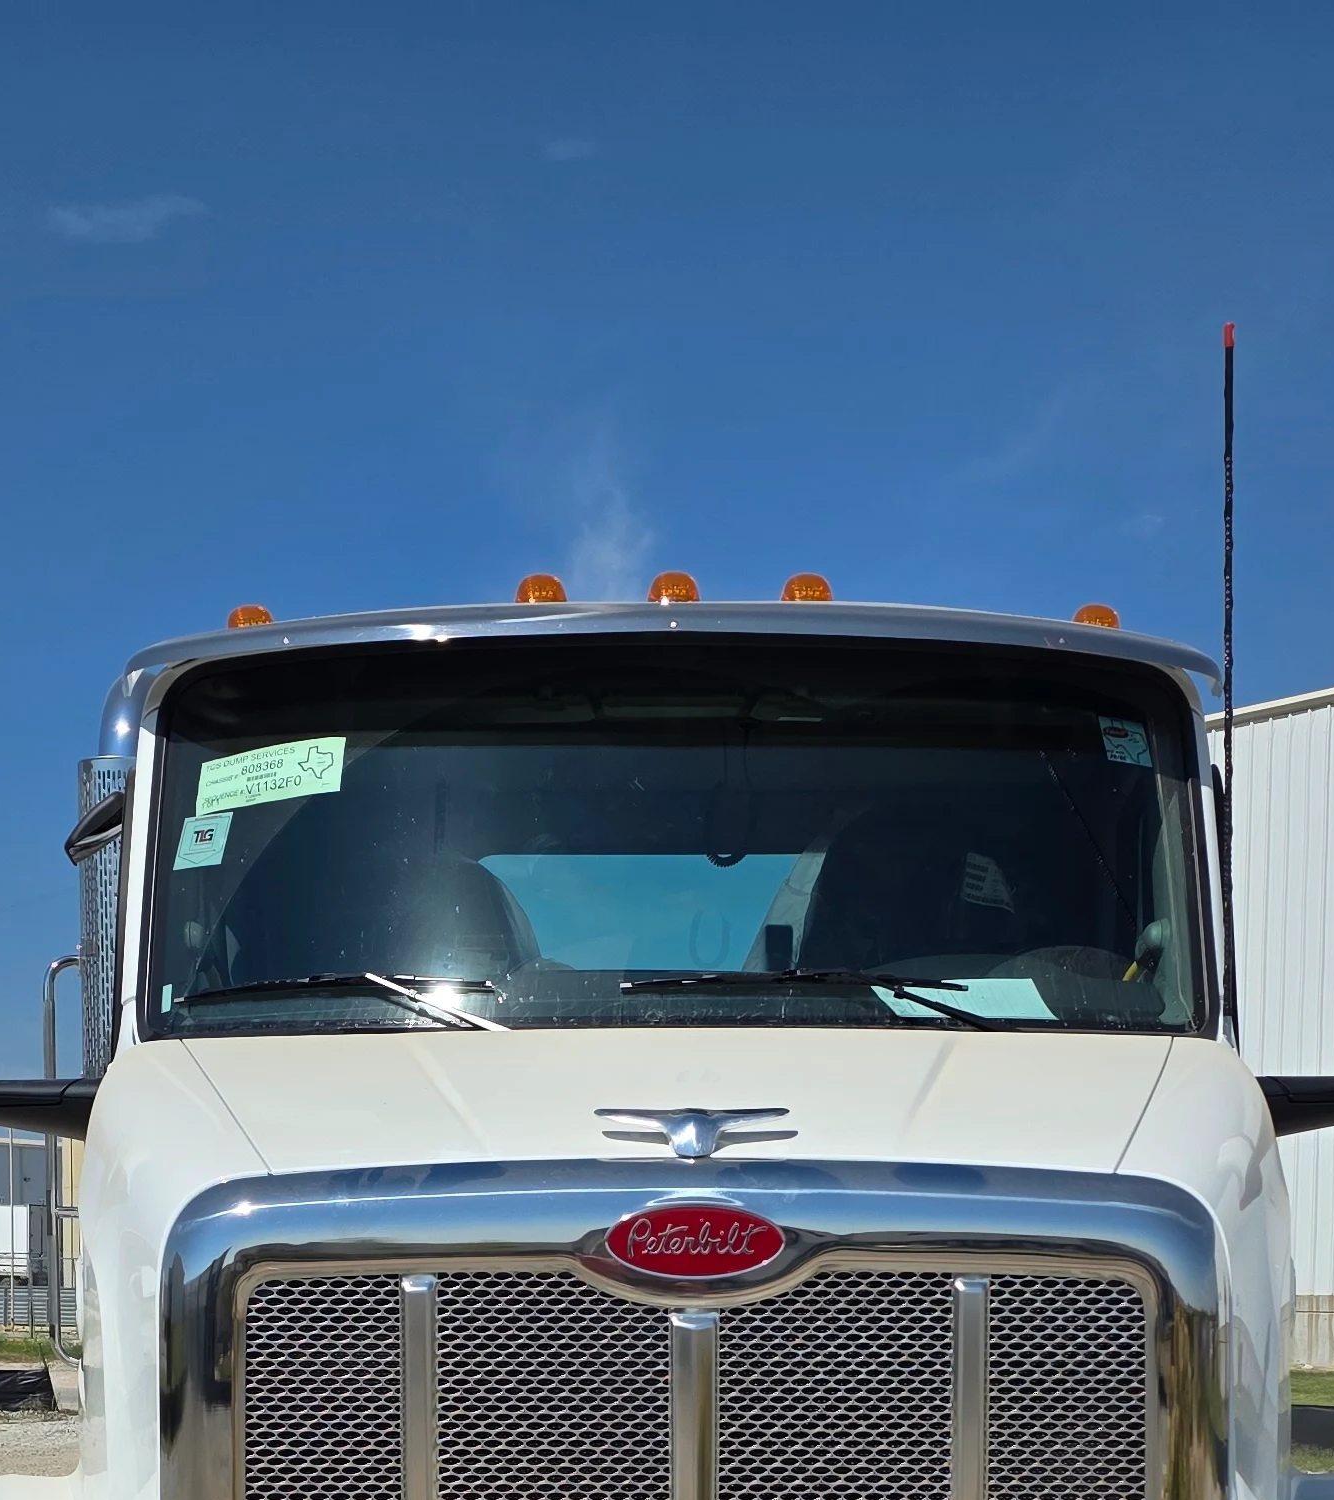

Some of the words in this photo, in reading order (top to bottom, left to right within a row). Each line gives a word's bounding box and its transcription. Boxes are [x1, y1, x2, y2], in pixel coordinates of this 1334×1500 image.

[223, 755, 248, 768] DUMP
[251, 746, 295, 761] SERVICES
[241, 758, 283, 775] 808368
[246, 774, 302, 795] V1132F0
[194, 829, 215, 843] TLG
[627, 1218, 768, 1259] Peterbilt
